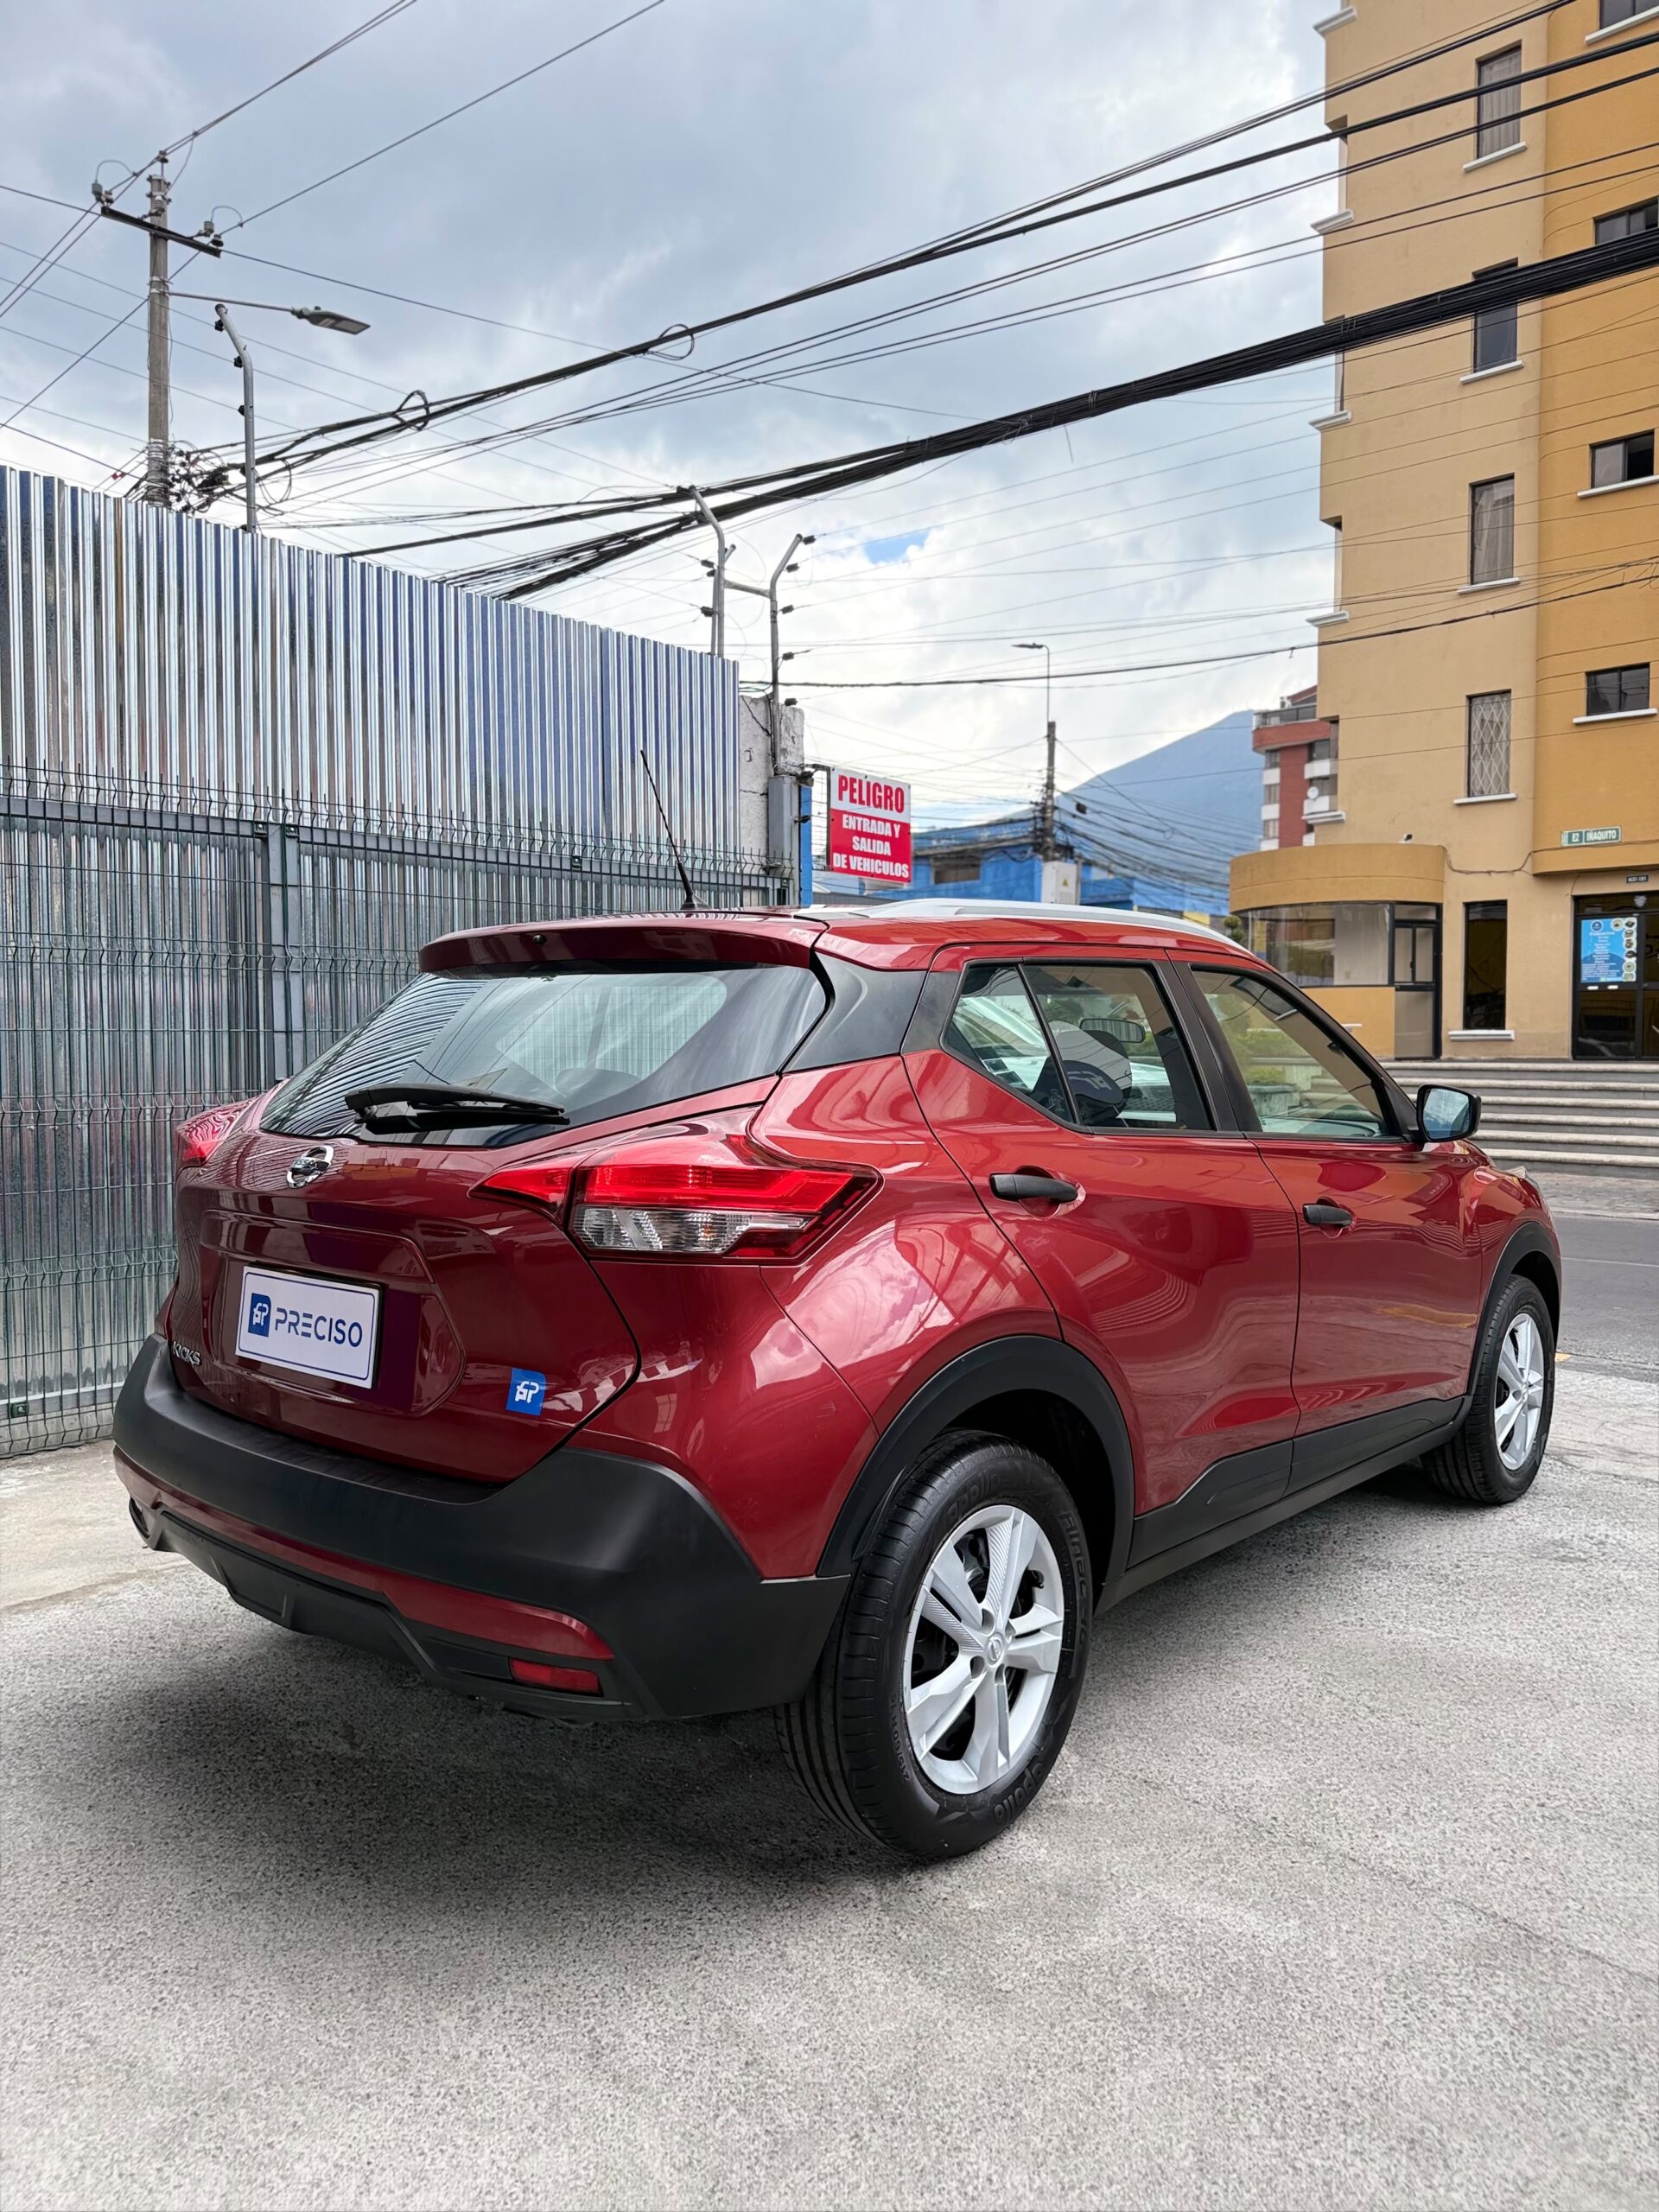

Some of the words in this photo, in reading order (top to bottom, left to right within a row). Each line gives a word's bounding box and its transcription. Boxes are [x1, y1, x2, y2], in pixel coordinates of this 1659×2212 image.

[838, 774, 905, 814] PELIGRO
[842, 814, 892, 837] ENTRADA
[893, 823, 901, 838] Y
[852, 836, 891, 856] SALIDA
[832, 852, 848, 869] DE
[849, 855, 909, 878] VEHICULOS
[275, 1307, 363, 1347] PRECISO
[173, 1340, 200, 1365] KICKS
[994, 1762, 1045, 1825] apollo
